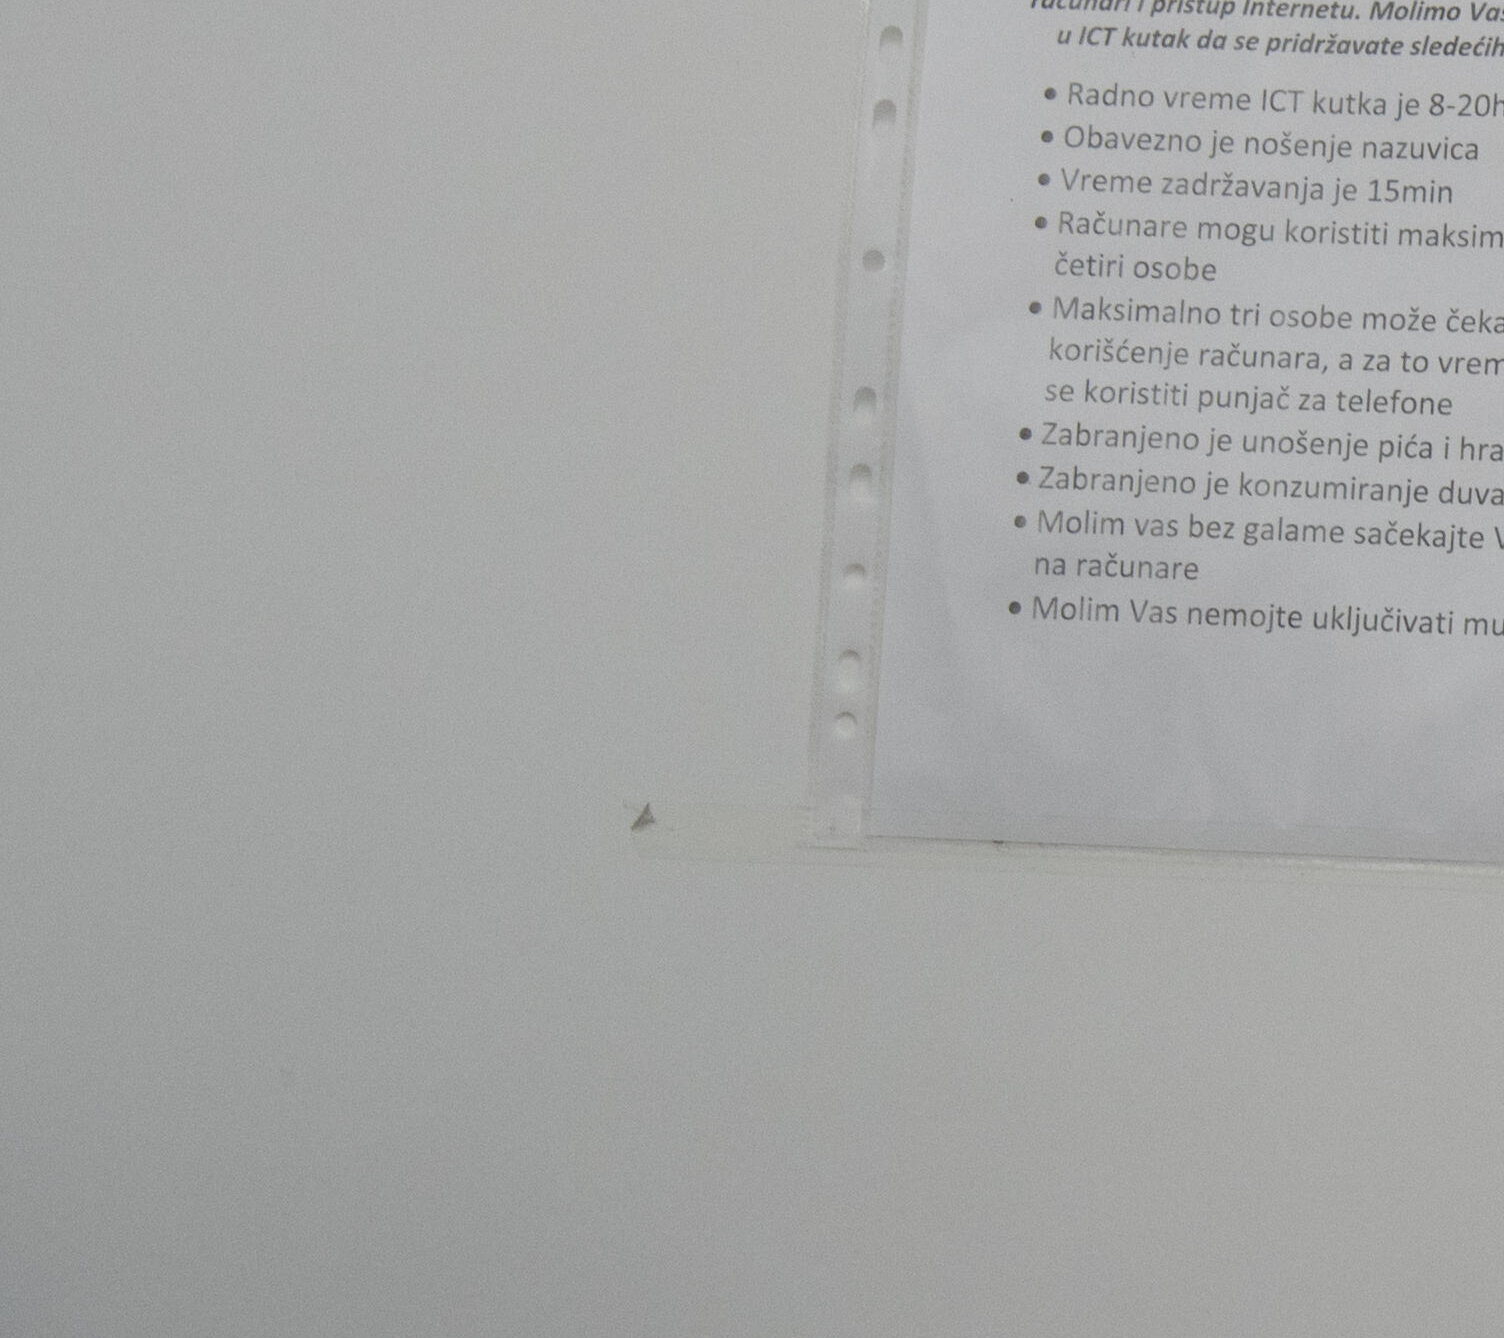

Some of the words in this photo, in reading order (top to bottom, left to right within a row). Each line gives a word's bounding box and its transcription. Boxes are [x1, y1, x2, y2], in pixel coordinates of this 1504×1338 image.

[1056, 29, 1073, 47] u
[1078, 24, 1118, 48] ICT
[1121, 25, 1191, 50] kutak
[1196, 27, 1229, 52] da
[1234, 33, 1261, 53] se
[1266, 31, 1406, 58] pridržavate
[1066, 80, 1156, 110] Radno
[1162, 89, 1253, 112] vreme
[1260, 87, 1305, 114] ICT
[1311, 88, 1388, 116] kutka
[1396, 91, 1421, 122] je
[1062, 122, 1203, 155] Obavezno
[1210, 128, 1236, 160] je
[1243, 129, 1354, 164] nošenje
[1361, 135, 1480, 162] nazuvica
[1060, 166, 1154, 196] Vreme
[1160, 170, 1325, 206] zadržavanja
[1333, 176, 1359, 207] je
[1367, 177, 1454, 205] 15min
[1057, 209, 1189, 241] Računare
[1196, 219, 1276, 248] mogu
[1283, 217, 1389, 247] koristiti
[1053, 249, 1125, 279] četiri
[1131, 254, 1218, 284] osobe
[1052, 294, 1223, 327] Maksimalno
[1229, 301, 1261, 328] tri
[1268, 303, 1354, 331] osobe
[1361, 305, 1438, 334] može
[1048, 335, 1190, 372] korišćenje
[1198, 341, 1329, 376] računara,
[1337, 350, 1354, 373] a
[1361, 351, 1392, 374] za
[1399, 350, 1431, 375] to
[1044, 382, 1076, 404] se
[1083, 377, 1189, 409] koristiti
[1196, 384, 1291, 417] punjač
[1296, 391, 1327, 413] za
[1335, 387, 1454, 418] telefone
[1040, 420, 1201, 457] Zabranjeno
[1207, 428, 1234, 459] je
[1241, 428, 1370, 464] unošenje
[1377, 432, 1435, 465] pića
[1442, 434, 1451, 462] i
[1037, 464, 1198, 500] Zabranjeno
[1203, 473, 1230, 503] je
[1238, 471, 1430, 511] konzumiranje
[1037, 508, 1126, 538] Molim
[1133, 516, 1180, 539] vas
[1187, 512, 1236, 542] bez
[1241, 514, 1346, 549] galame
[1353, 520, 1486, 554] sačekajte
[1033, 555, 1068, 578] na
[1075, 551, 1200, 583] računare
[1031, 594, 1121, 624] Molim
[1128, 597, 1179, 627] Vas
[1186, 602, 1304, 636] nemojte
[1311, 604, 1455, 638] uključivati
